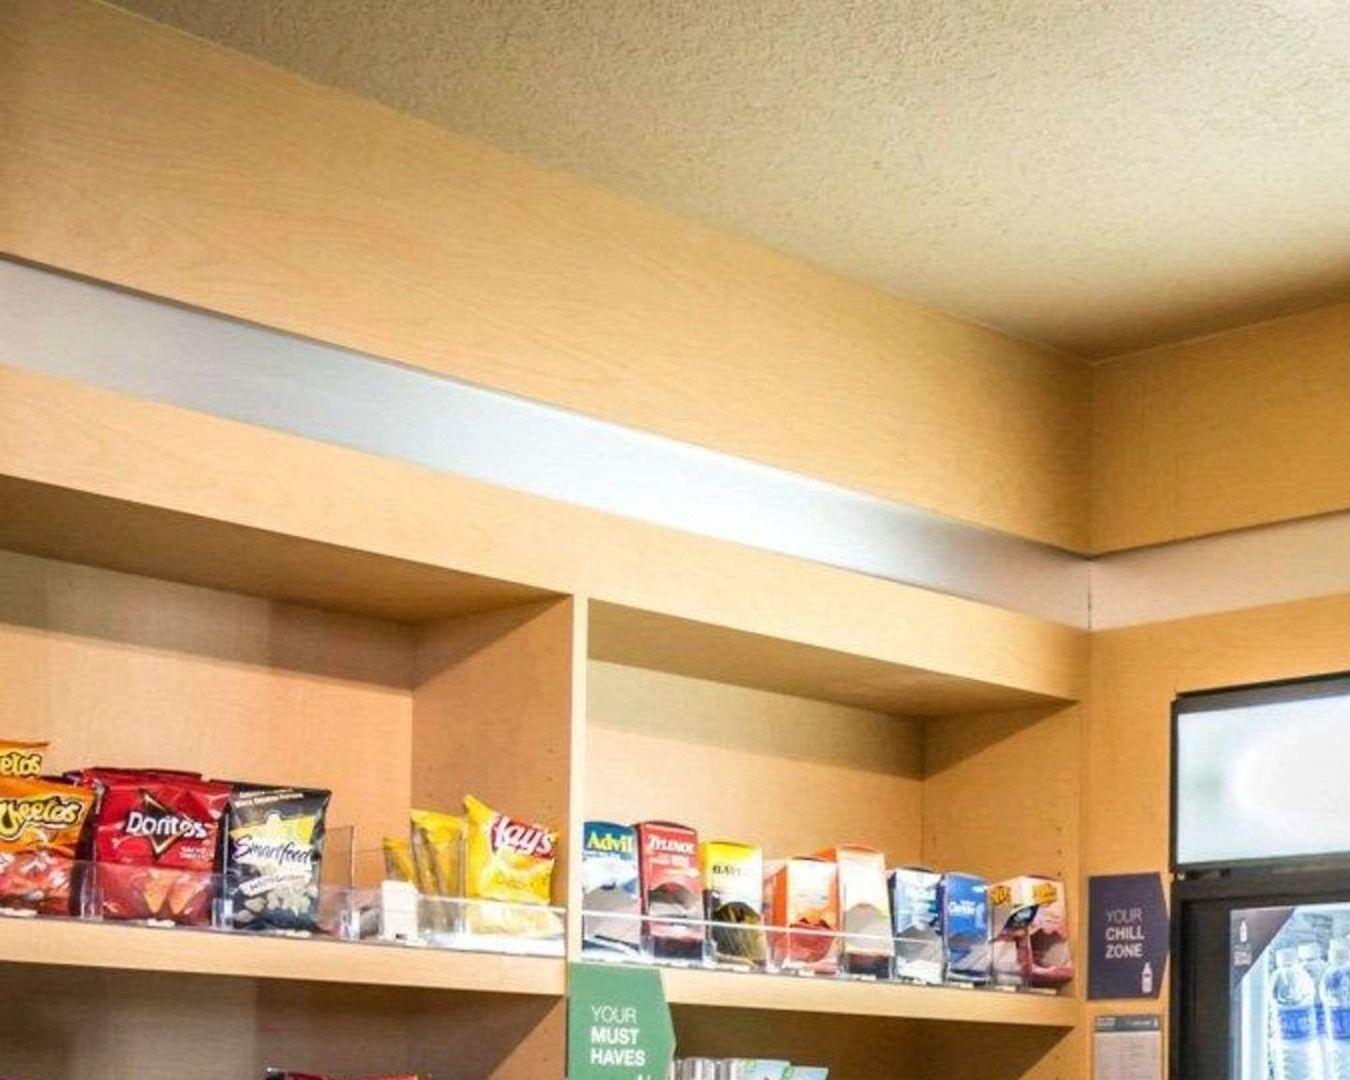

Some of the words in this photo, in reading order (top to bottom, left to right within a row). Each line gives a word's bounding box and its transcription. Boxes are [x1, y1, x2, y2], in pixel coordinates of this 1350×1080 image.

[126, 811, 208, 838] Doritos
[490, 815, 554, 855] Lay's
[587, 831, 633, 851] Advil
[1105, 908, 1142, 923] YOUR
[1105, 926, 1145, 941] CHILL
[1105, 943, 1143, 959] ZONE
[590, 1005, 637, 1024] YOUR
[590, 1027, 640, 1045] MUST
[589, 1048, 646, 1067] HAVES
